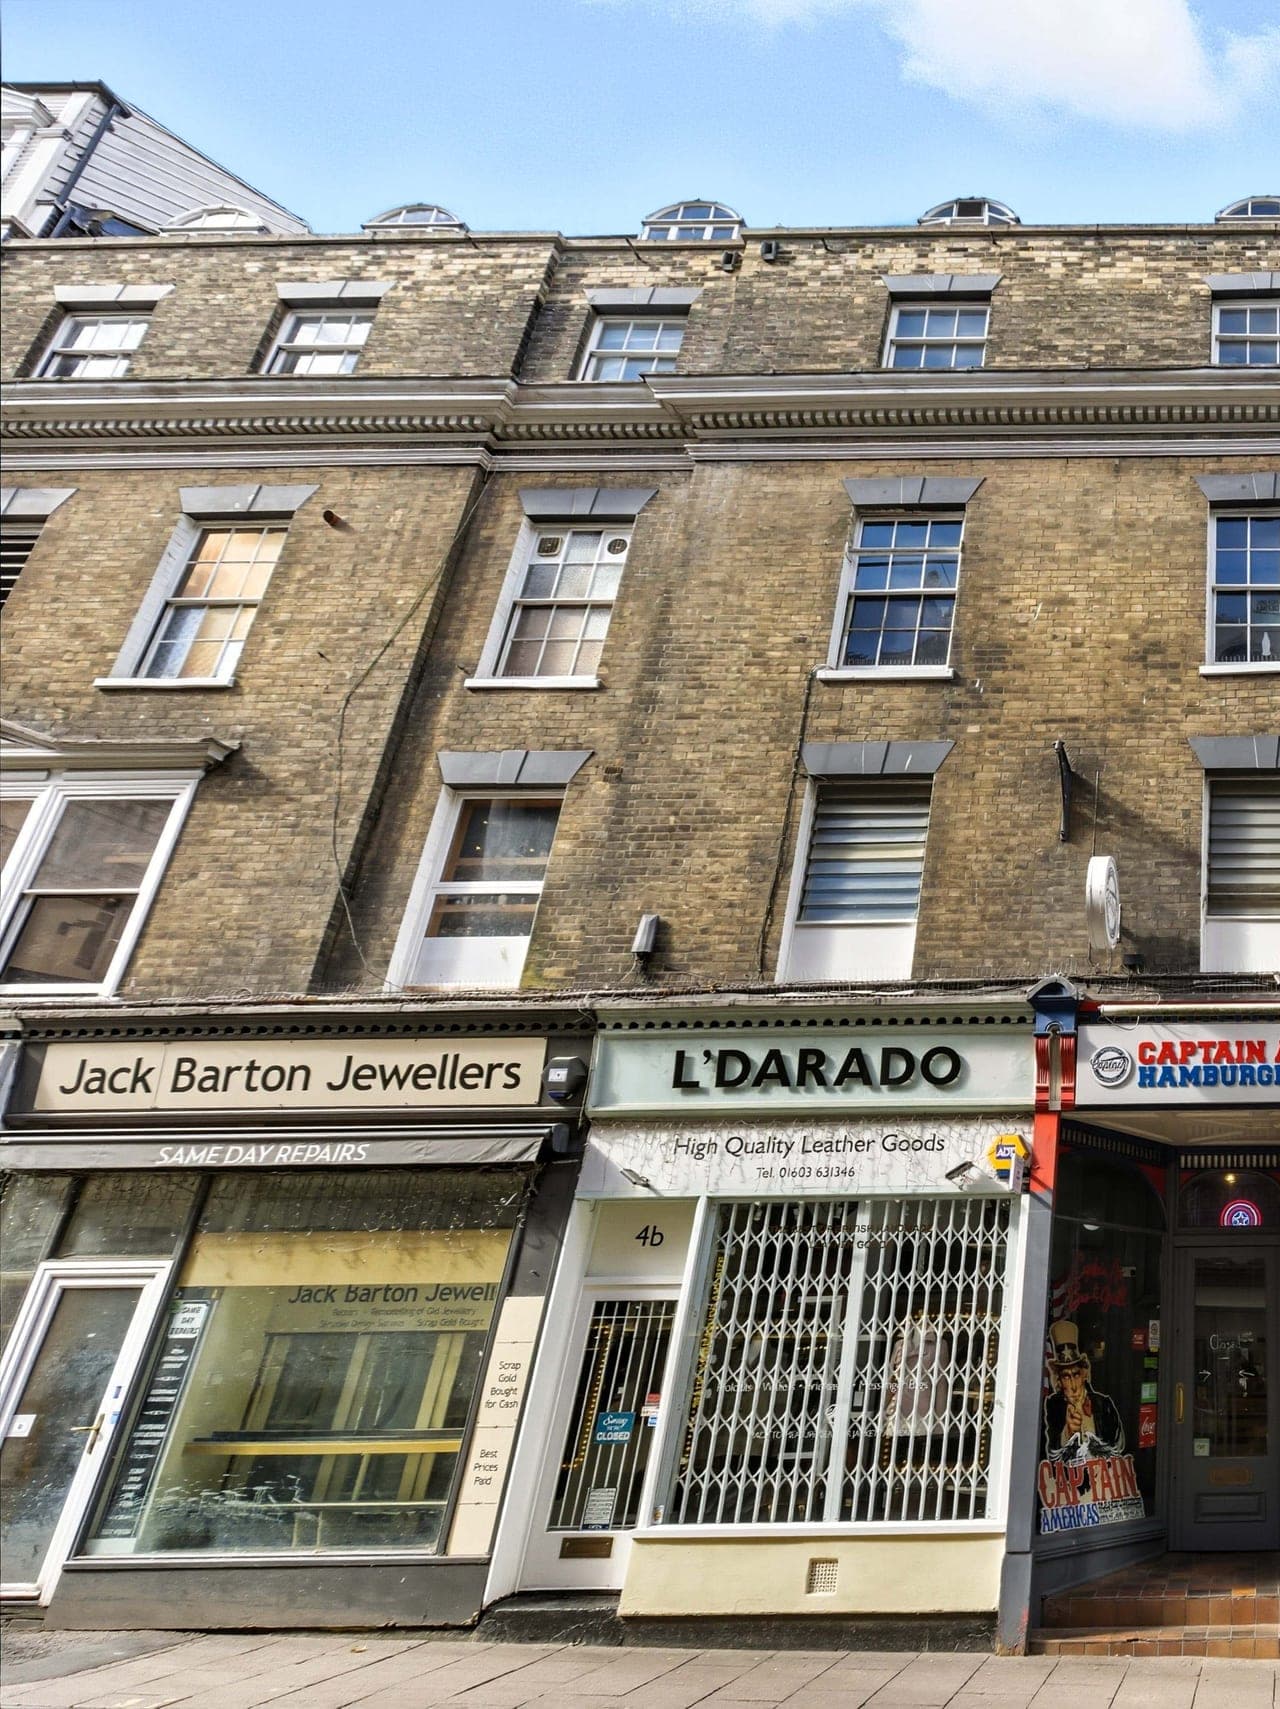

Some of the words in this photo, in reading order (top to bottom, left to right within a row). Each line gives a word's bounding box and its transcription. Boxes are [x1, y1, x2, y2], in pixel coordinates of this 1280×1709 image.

[1138, 1040, 1267, 1066] CAPTAIN
[60, 1057, 155, 1095] Jack
[170, 1056, 311, 1094] Barton
[327, 1053, 522, 1092] Jewellers
[672, 1046, 962, 1089] L'DARADO
[156, 1146, 223, 1165] SAME
[224, 1145, 273, 1163] DAY
[275, 1143, 370, 1163] REPAIRS
[673, 1138, 718, 1162] High
[725, 1137, 795, 1159] Quality
[802, 1134, 876, 1154] Leather
[882, 1134, 945, 1153] Goods
[756, 1167, 775, 1179] Tel.
[779, 1167, 813, 1178] 01603
[816, 1166, 856, 1178] 631346
[634, 1225, 666, 1247] 4b
[288, 1284, 338, 1303] Jack
[499, 1361, 521, 1370] Scrap
[498, 1374, 517, 1383] Gold
[490, 1387, 518, 1397] Bought
[485, 1400, 496, 1409] for
[499, 1400, 518, 1409] Cash
[596, 1431, 631, 1441] CLOSED
[480, 1449, 498, 1458] Best
[473, 1463, 499, 1472] Prices
[474, 1477, 492, 1486] Paid
[1038, 1455, 1141, 1510] CAPTAIN
